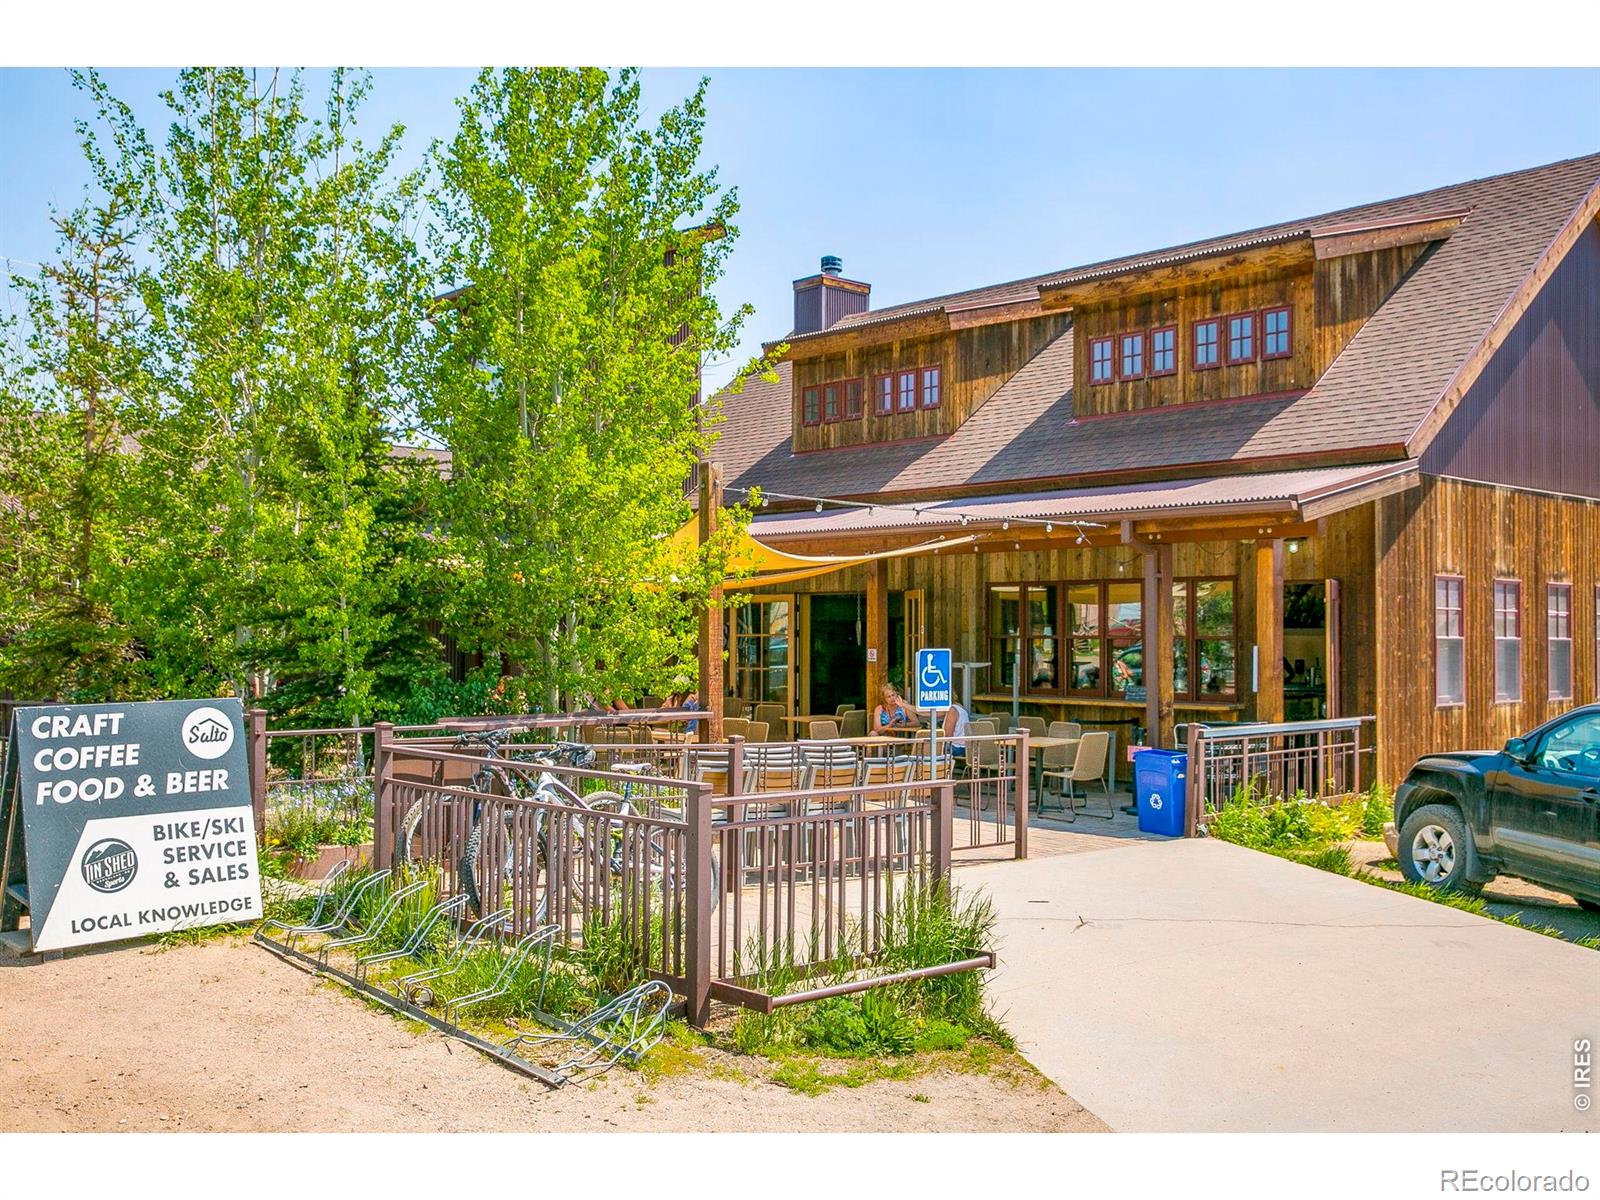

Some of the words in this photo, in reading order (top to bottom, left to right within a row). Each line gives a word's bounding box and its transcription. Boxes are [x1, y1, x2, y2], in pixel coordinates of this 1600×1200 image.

[920, 690, 948, 701] PARKING
[31, 712, 124, 739] CRAFT
[188, 725, 228, 744] Salto
[33, 743, 140, 772] COFFEE
[36, 776, 125, 805] FOOD
[133, 774, 156, 798] &
[165, 769, 229, 795] BEER
[152, 817, 245, 841] BIKE/SKI
[163, 840, 247, 865] SERVICE
[83, 862, 102, 884] TIN
[104, 851, 135, 877] SHED
[164, 871, 180, 889] &
[188, 863, 249, 886] SALES
[71, 912, 132, 934] LOCAL
[138, 896, 252, 925] KNOWLEDGE
